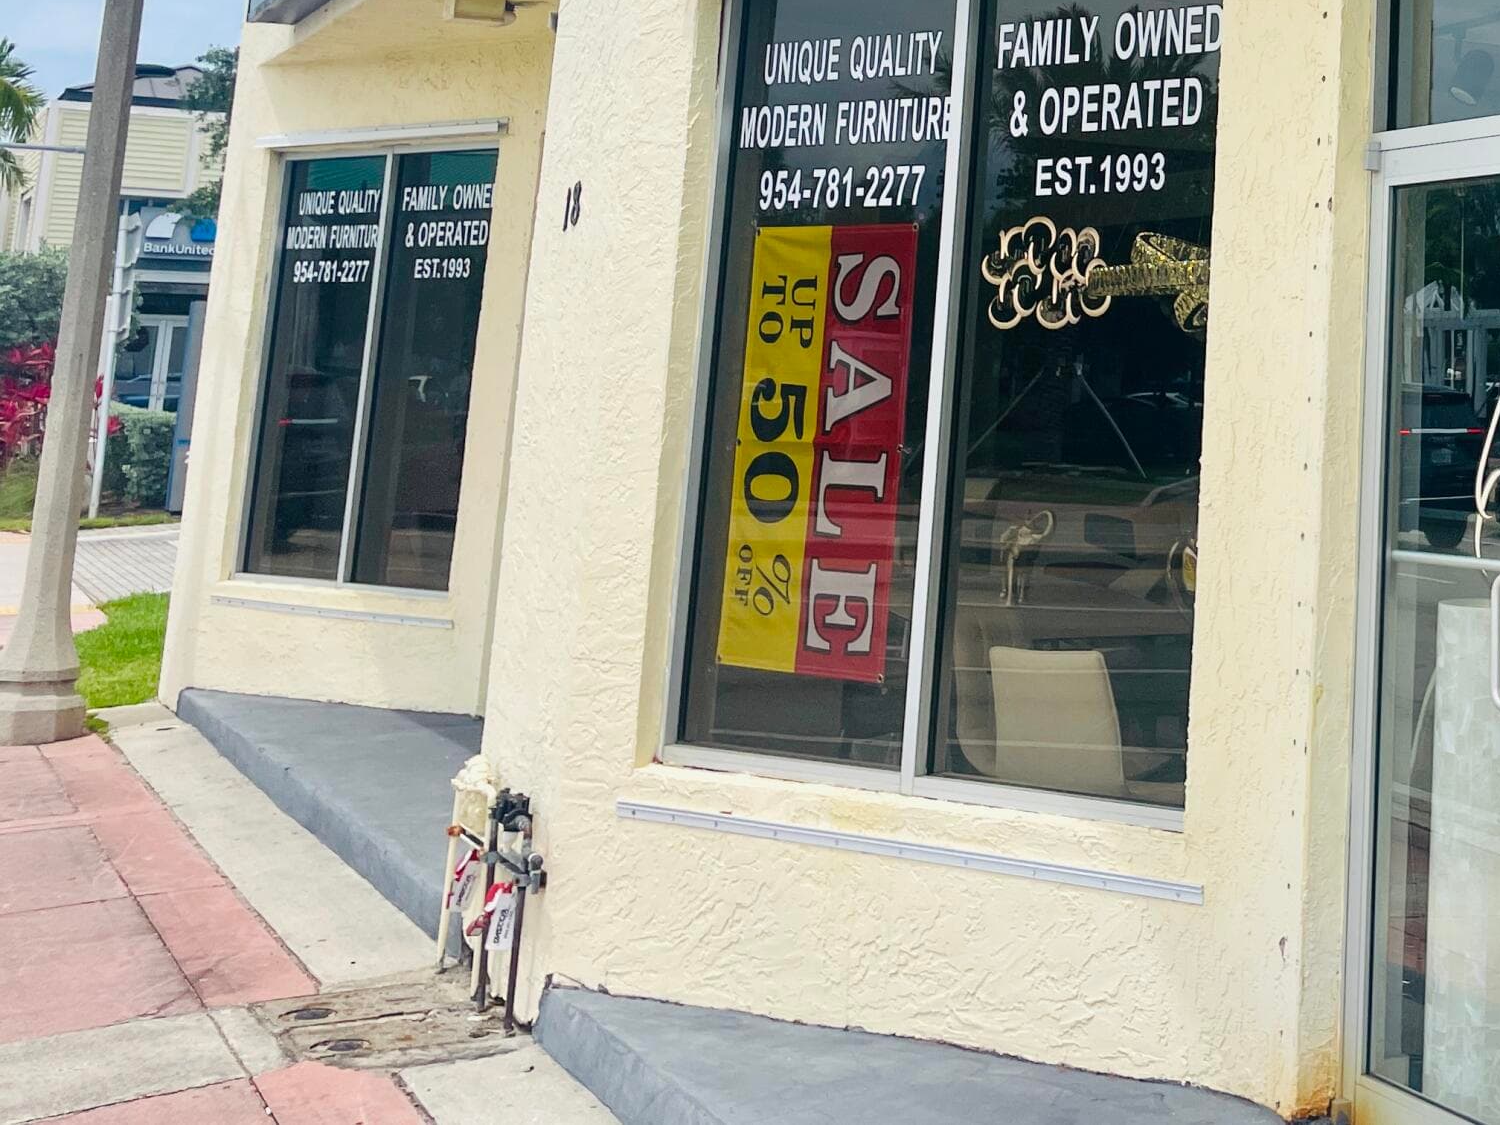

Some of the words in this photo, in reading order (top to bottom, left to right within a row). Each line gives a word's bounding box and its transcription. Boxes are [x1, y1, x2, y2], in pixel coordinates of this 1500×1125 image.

[764, 38, 842, 86] UNIQUE
[850, 31, 943, 82] QUALITY
[997, 15, 1099, 69] FAMILY
[1114, 4, 1223, 61] OWNED
[740, 103, 828, 149] MODERN
[1009, 89, 1029, 138] &
[1039, 77, 1204, 136] OPERATED
[402, 185, 448, 211] FAMILY
[452, 183, 494, 210] OWNE
[759, 165, 926, 211] 954-781-2277
[1035, 152, 1166, 197] EST.1993
[299, 191, 337, 216] UNIQUE
[338, 189, 381, 215] QUALITY
[562, 180, 582, 232] 18
[286, 225, 328, 250] MODERN
[405, 222, 414, 248] &
[418, 220, 489, 248] OPERATED
[293, 260, 370, 283] 954-781-2277
[758, 274, 788, 344] TO
[790, 274, 818, 349] UP
[802, 252, 902, 657] SALE
[736, 544, 753, 607] OFF
